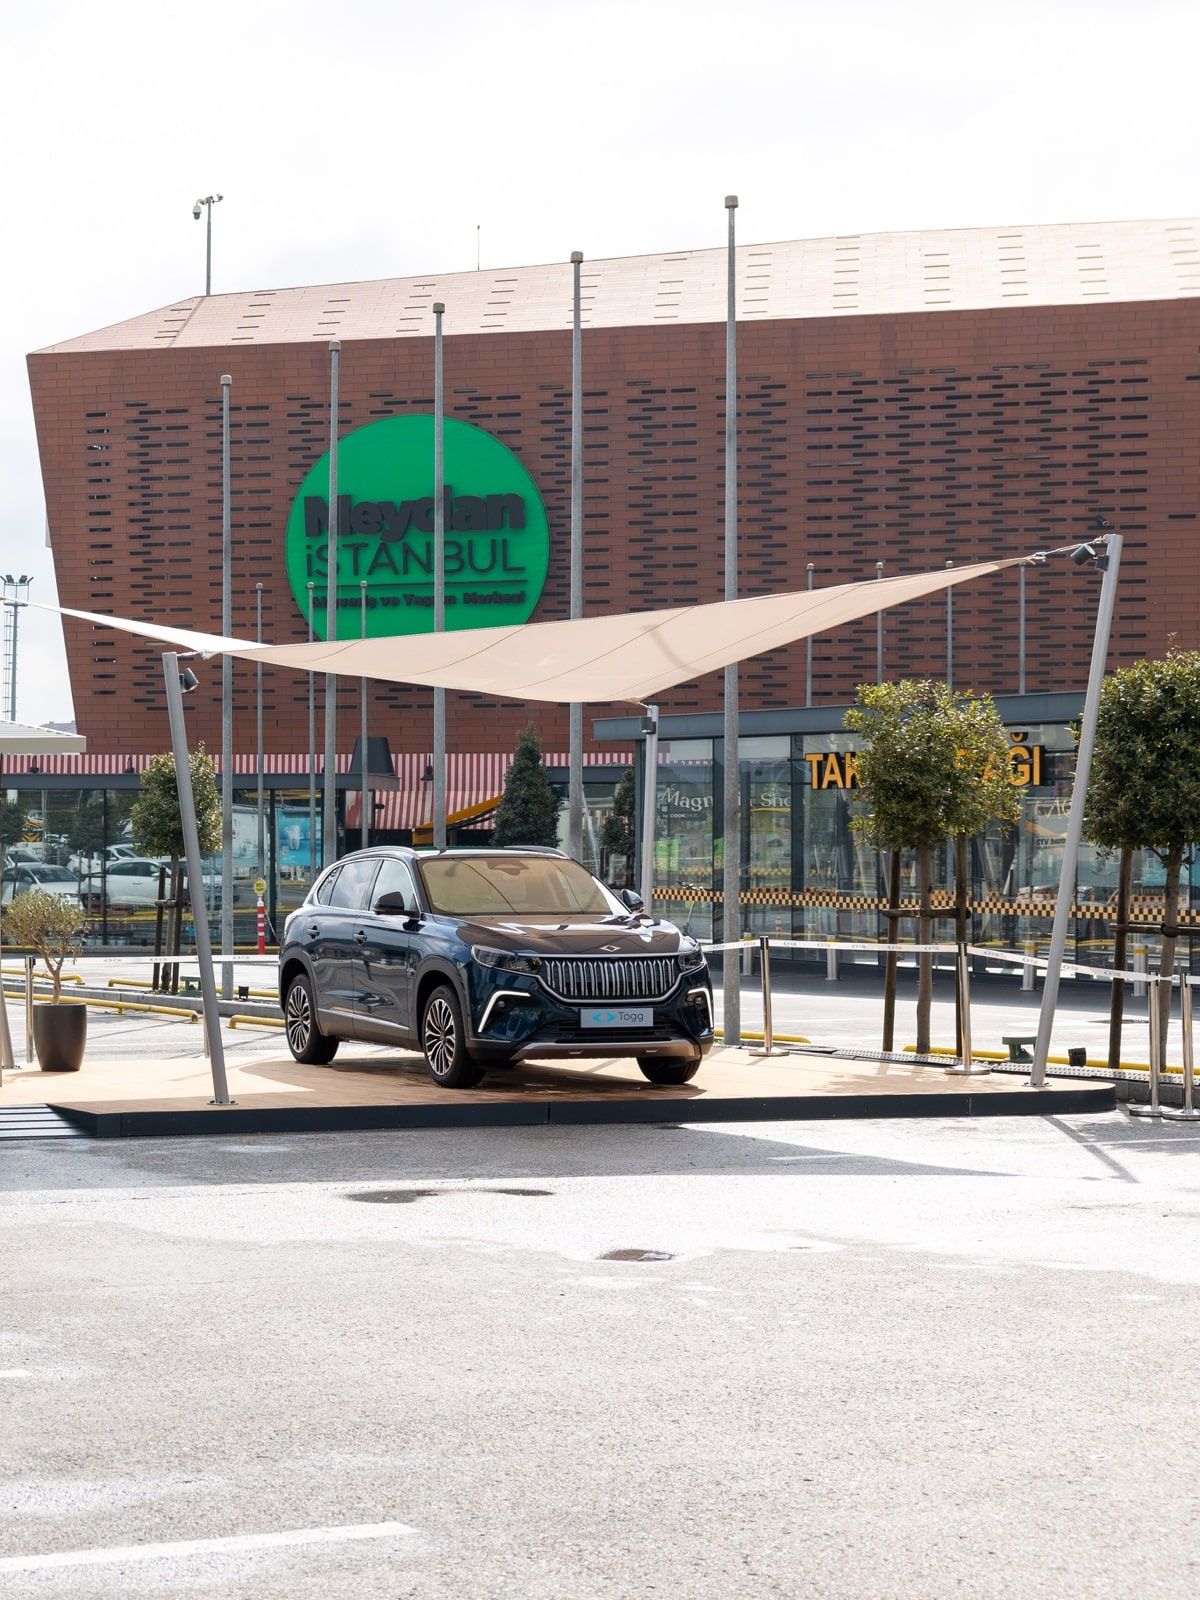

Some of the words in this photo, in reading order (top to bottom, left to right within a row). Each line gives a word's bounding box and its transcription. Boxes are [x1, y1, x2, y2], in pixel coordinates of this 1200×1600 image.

[304, 484, 526, 543] Meydan
[805, 752, 870, 790] TAK
[618, 1011, 644, 1023] Togg
